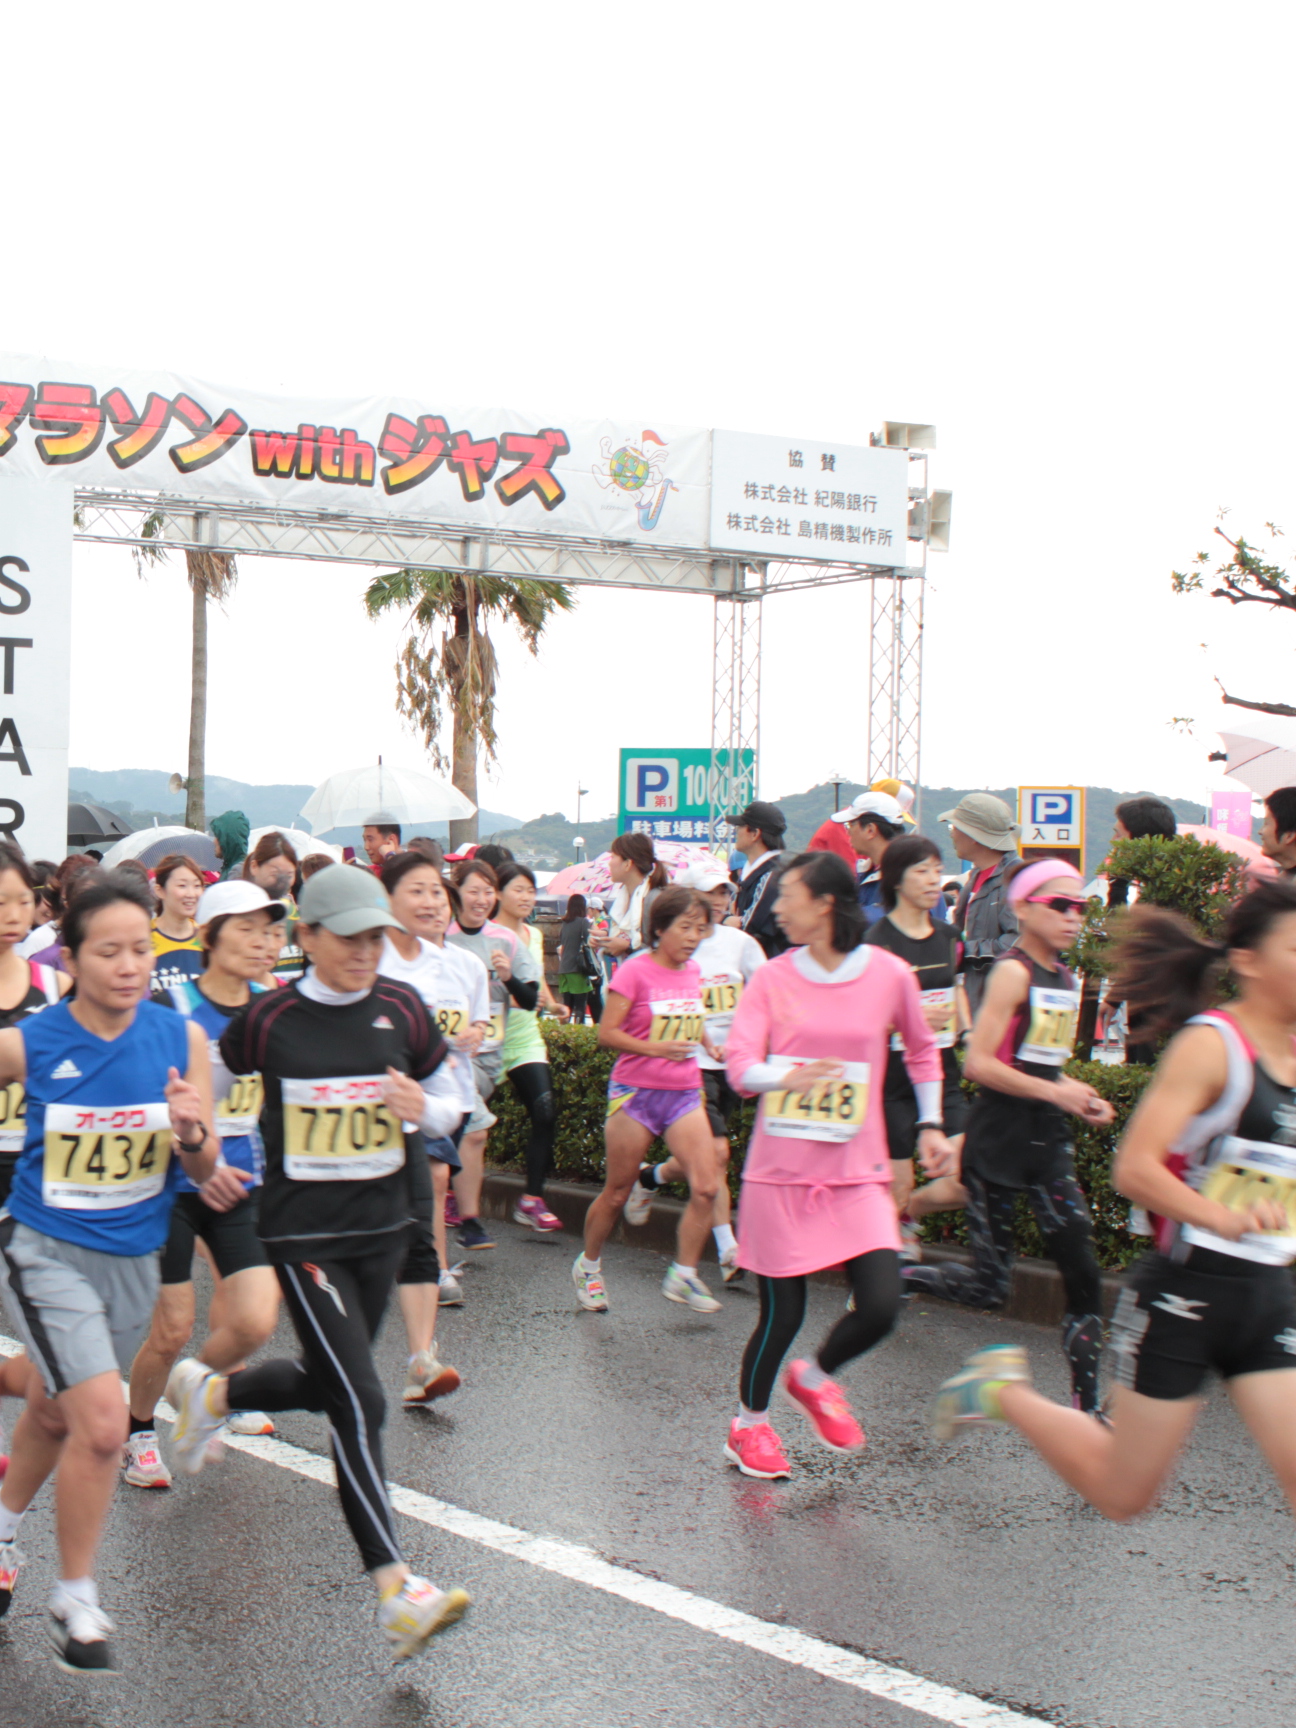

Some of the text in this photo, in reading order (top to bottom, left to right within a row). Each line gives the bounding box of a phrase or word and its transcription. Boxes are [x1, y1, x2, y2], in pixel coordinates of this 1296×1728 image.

[744, 481, 878, 513] 株式会社 紀陽銀行
[727, 512, 893, 547] 株式会社 島精機製作所
[637, 765, 669, 807] P
[654, 795, 673, 808] 第1
[1036, 795, 1068, 822] P
[631, 820, 736, 838] 駐車場料金
[1032, 828, 1070, 841] 入口
[310, 1081, 381, 1101] オークワ
[76, 1109, 147, 1129] オークワ
[299, 1104, 392, 1152] 7705
[60, 1132, 158, 1181] 7434
